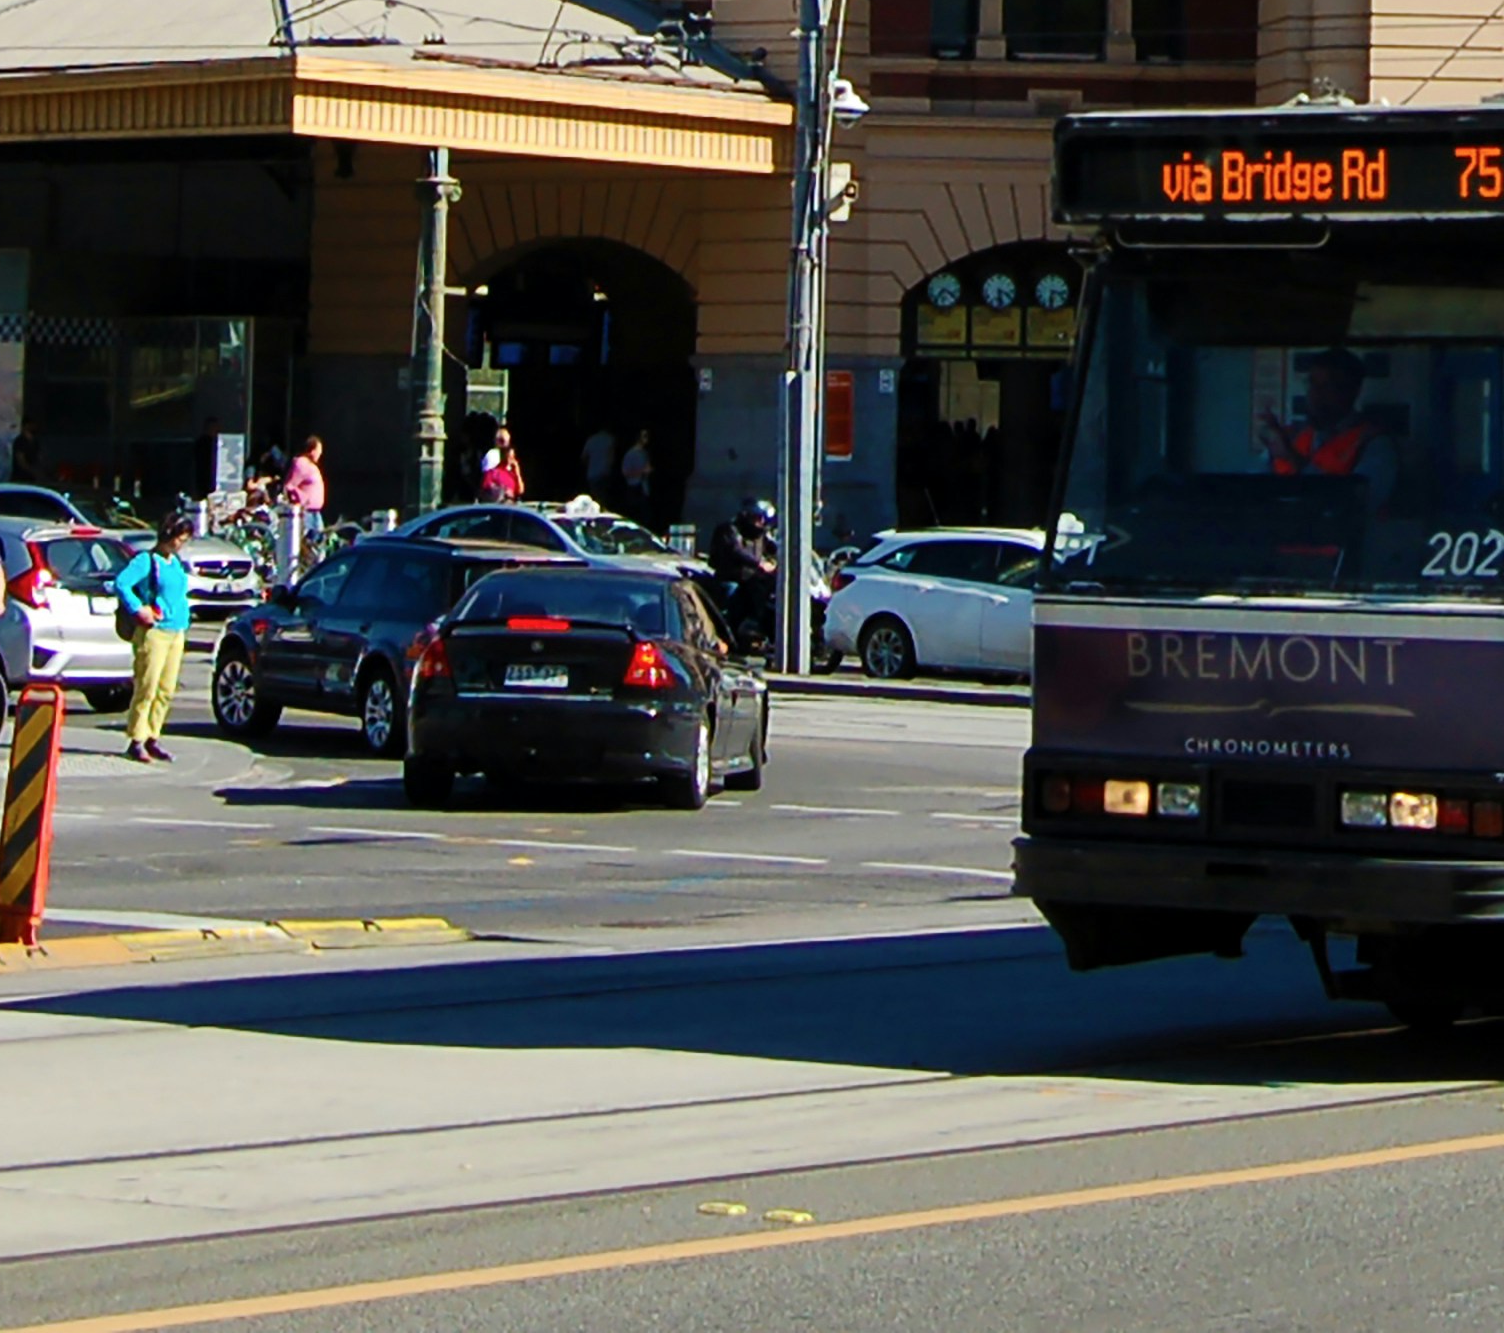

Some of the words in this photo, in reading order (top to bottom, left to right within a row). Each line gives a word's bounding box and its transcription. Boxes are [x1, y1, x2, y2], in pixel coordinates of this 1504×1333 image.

[1163, 151, 1212, 201] via
[1222, 151, 1333, 201] Bridge
[1342, 149, 1385, 200] Rd
[1454, 147, 1502, 198] 75
[1126, 632, 1405, 685] BREMONT
[1185, 737, 1351, 758] CHRONOMETERS
